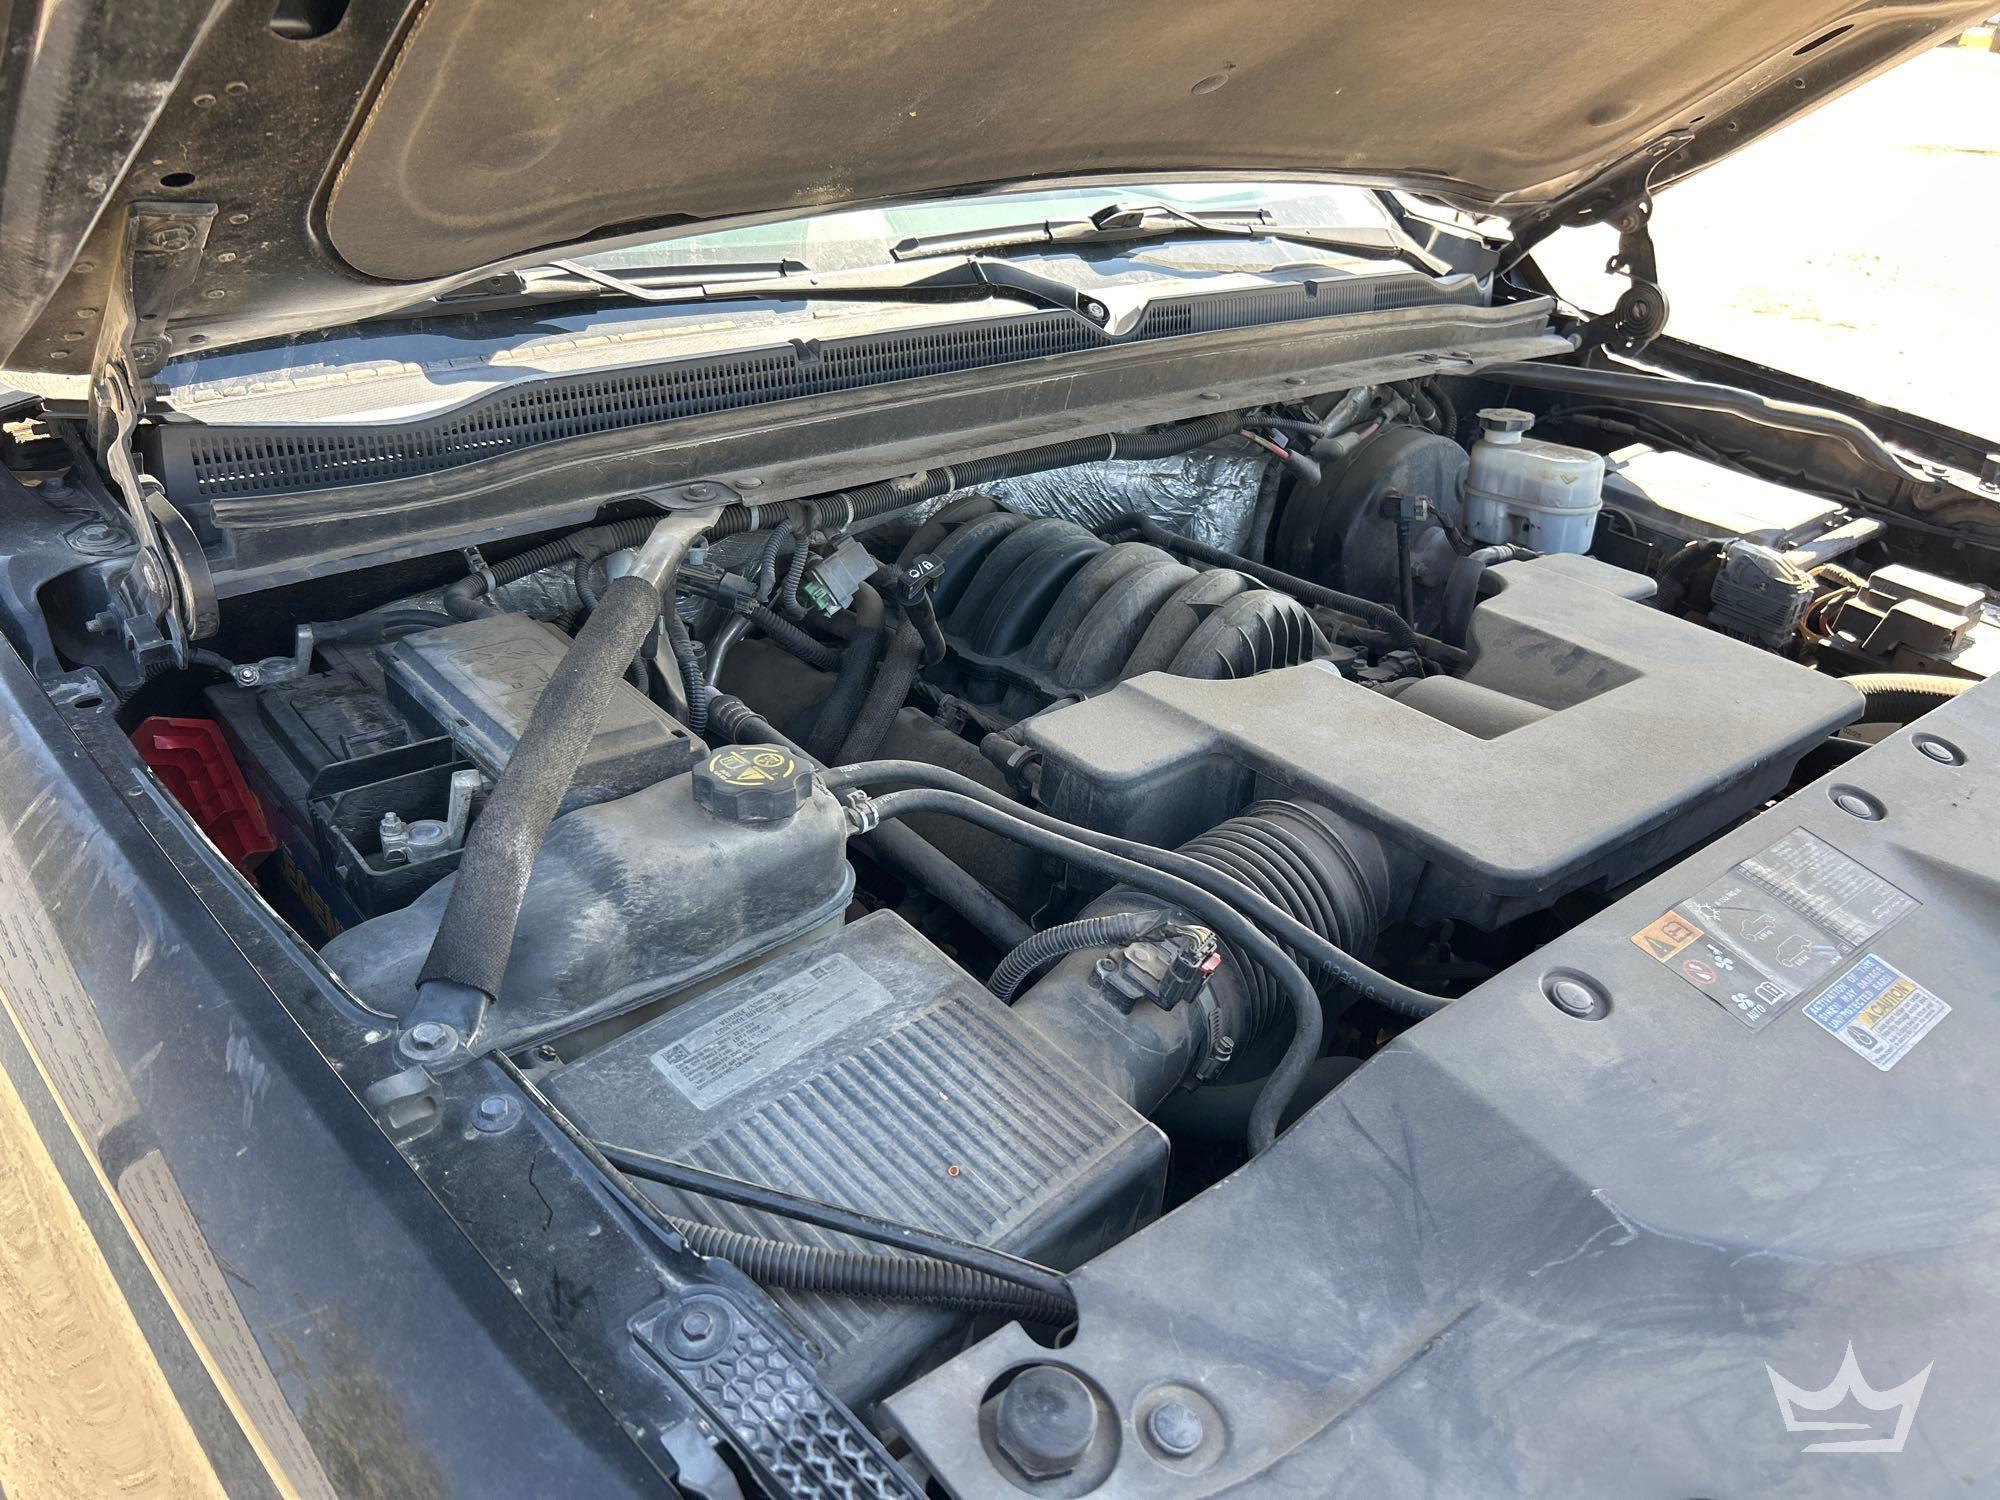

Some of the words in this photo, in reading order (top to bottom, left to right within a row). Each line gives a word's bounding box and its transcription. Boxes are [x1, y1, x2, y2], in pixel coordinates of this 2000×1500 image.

[1809, 982, 1849, 1015] ACTIVATION
[1857, 959, 1876, 973] THIS
[1840, 988, 1859, 1003] MAY
[1856, 966, 1885, 990] DAMAGE
[1871, 983, 1909, 1016] CAUTION
[715, 1016, 746, 1036] CONTROL
[719, 1008, 748, 1025] VEHICLE
[1746, 1004, 1767, 1021] AUTO
[1828, 990, 1874, 1029] UNPROTECTED
